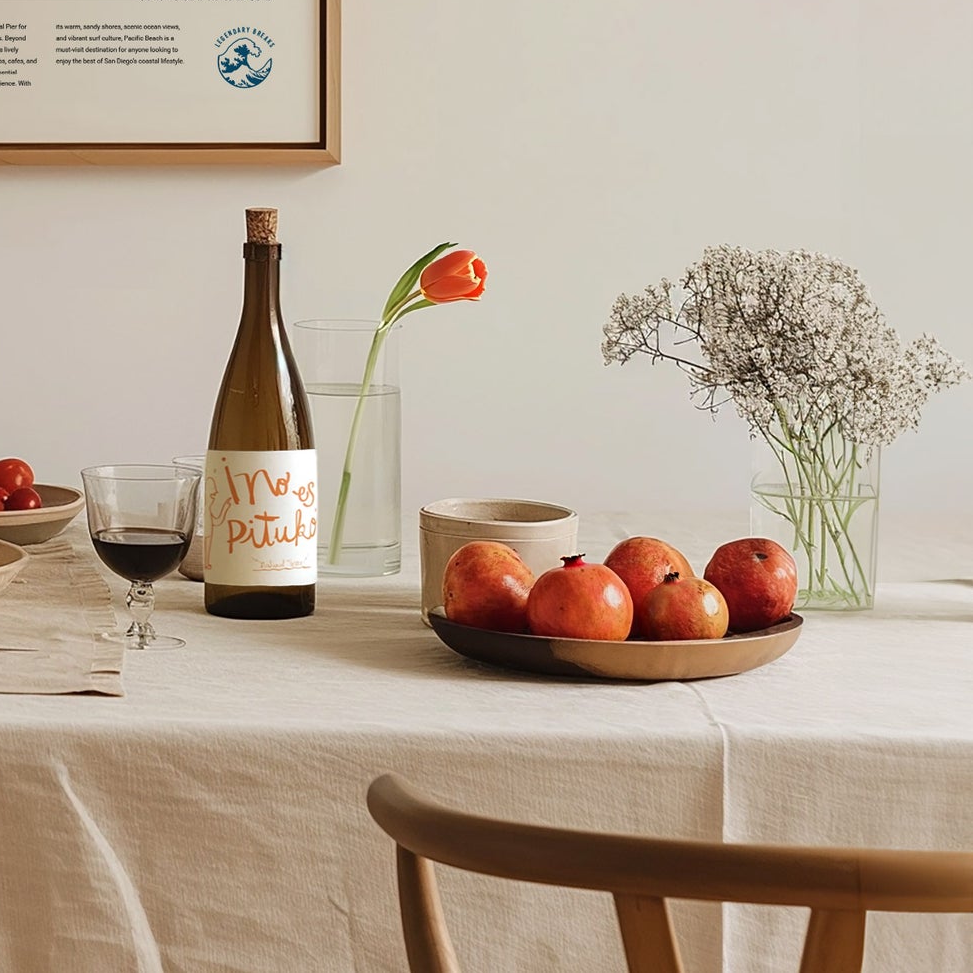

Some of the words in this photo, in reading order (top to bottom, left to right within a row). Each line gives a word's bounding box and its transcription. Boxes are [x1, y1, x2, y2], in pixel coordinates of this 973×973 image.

[83, 23, 101, 32] sandy
[5, 35, 27, 44] Beyond
[214, 27, 250, 47] LEGENDARY
[252, 28, 275, 47] BREAKS
[4, 46, 19, 55] lively
[128, 47, 149, 55] anyone
[150, 46, 171, 55] looking
[56, 58, 72, 66] enjoy
[117, 57, 138, 66] Diego's
[292, 481, 315, 507] es
